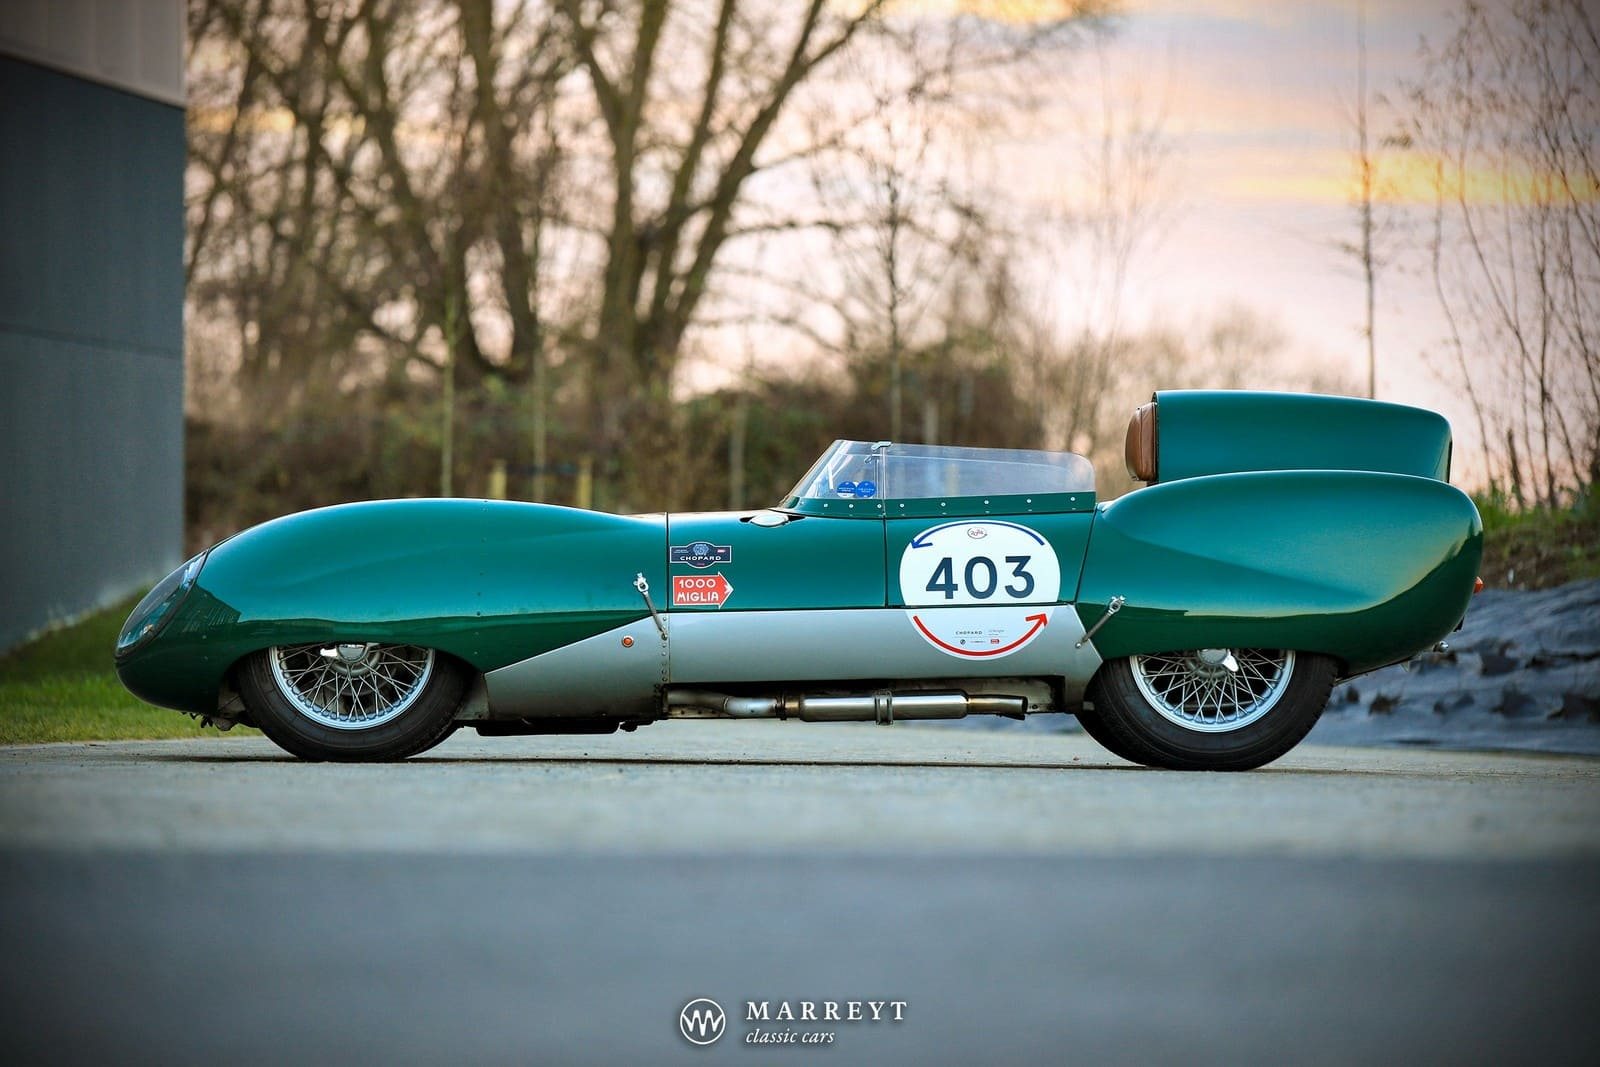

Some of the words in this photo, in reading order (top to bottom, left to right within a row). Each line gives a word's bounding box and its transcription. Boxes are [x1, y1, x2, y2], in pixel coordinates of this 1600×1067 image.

[926, 556, 1035, 599] 403
[679, 579, 716, 588] 1000
[677, 592, 719, 602] MIGLIA
